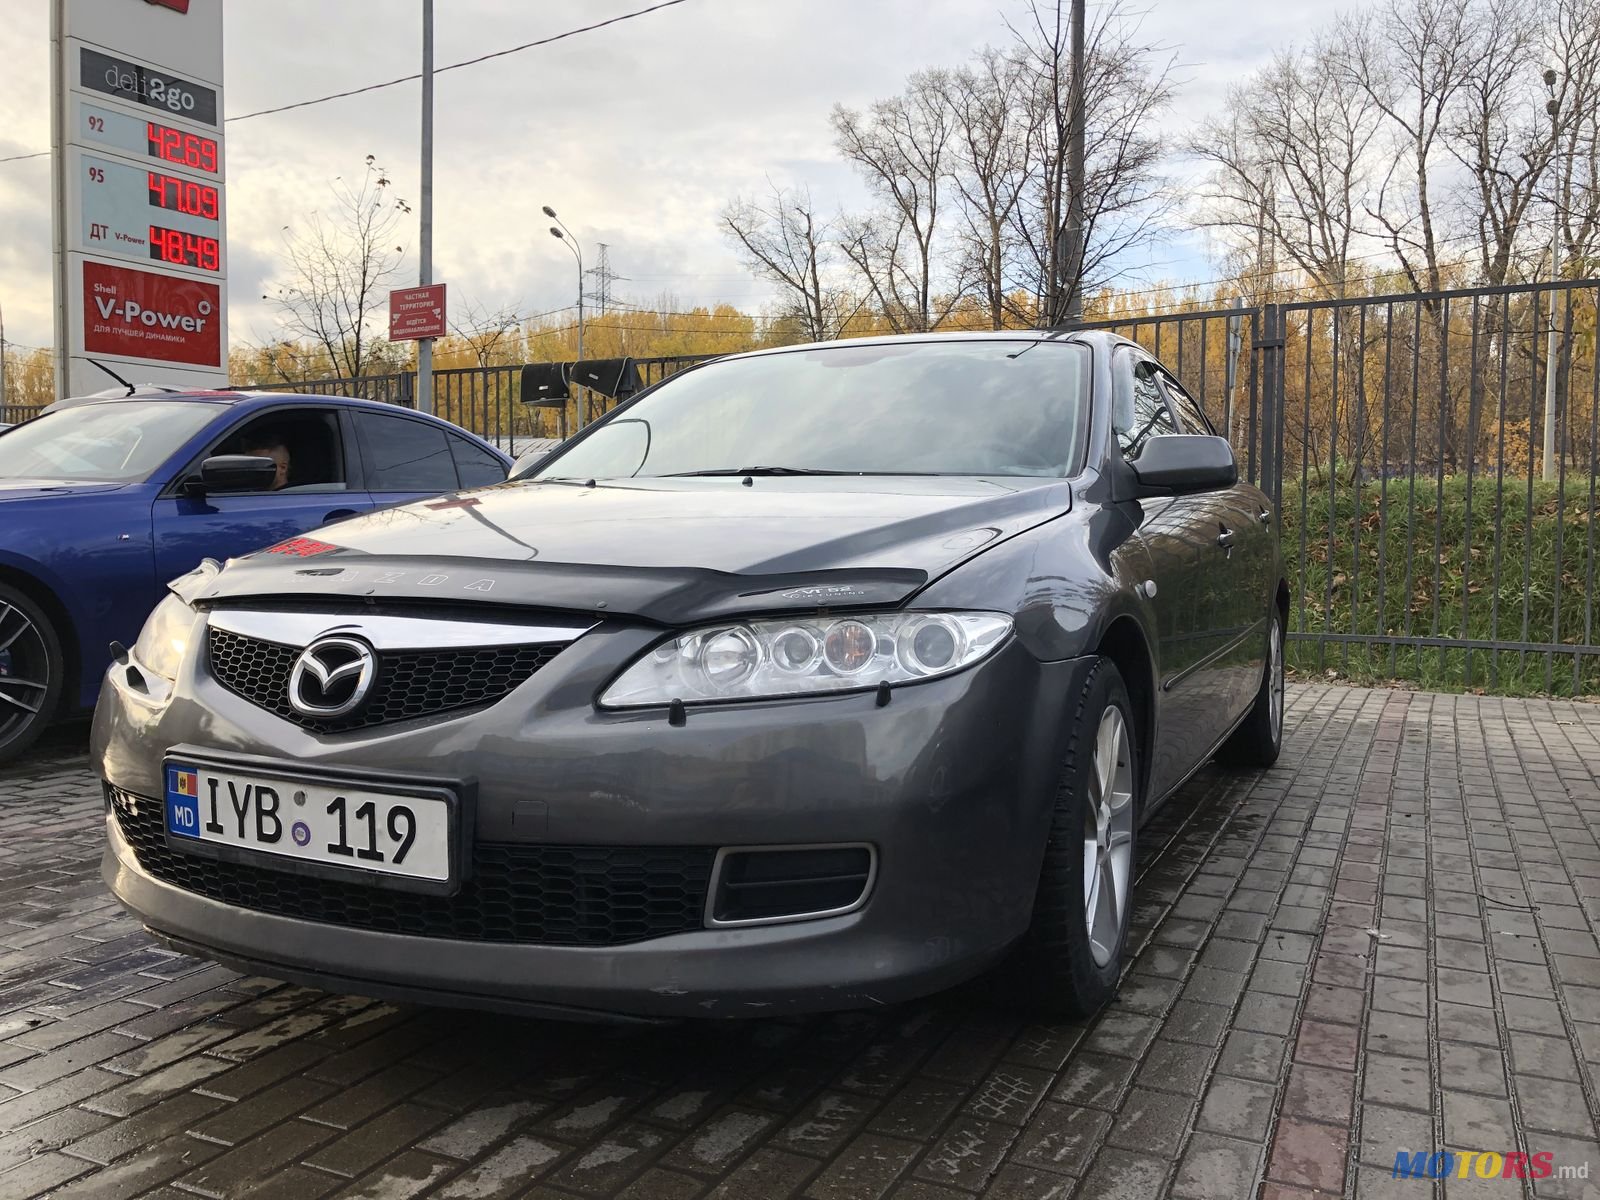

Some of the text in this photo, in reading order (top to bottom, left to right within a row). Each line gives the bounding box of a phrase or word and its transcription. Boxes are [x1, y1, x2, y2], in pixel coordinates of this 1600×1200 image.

[105, 65, 194, 110] deli2go
[88, 116, 104, 133] 92
[89, 167, 104, 183] 95
[90, 223, 145, 245] ДТ V-Power
[94, 283, 117, 294] Shell
[95, 296, 206, 333] V-Power
[400, 301, 434, 310] ТЕРРИТОРИЯ
[145, 332, 186, 344] ДИНАМИКИ
[174, 804, 194, 828] MD
[206, 777, 417, 864] IYB 119
